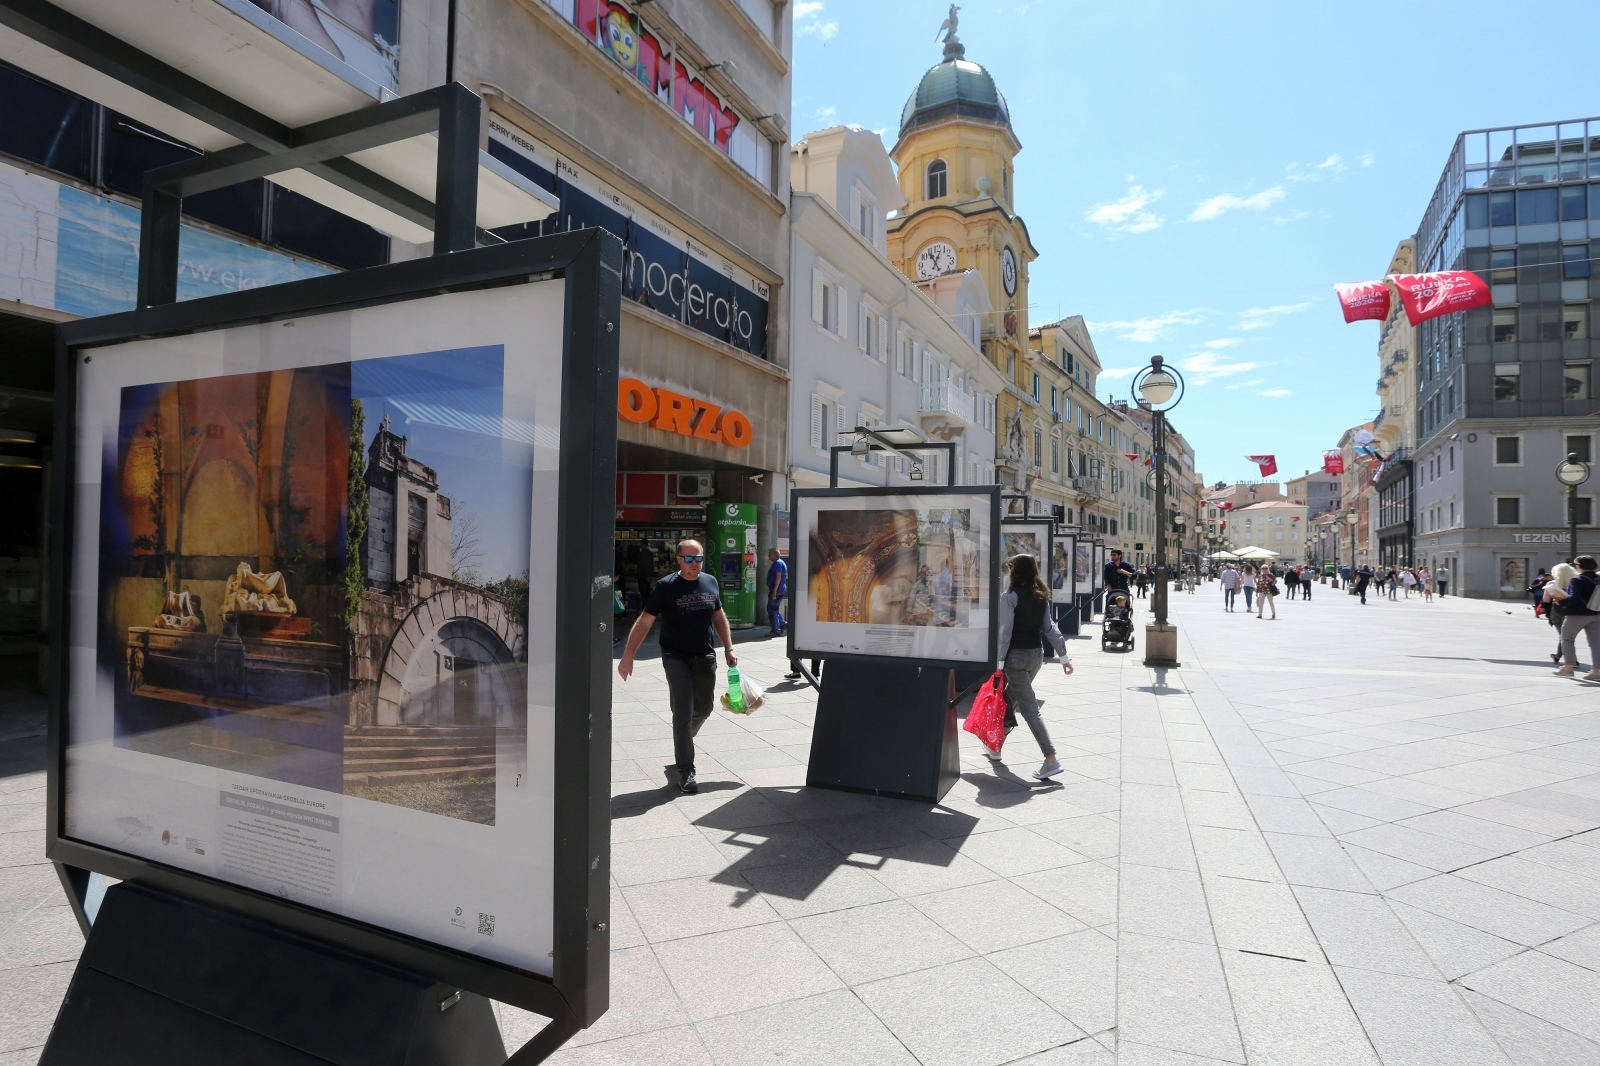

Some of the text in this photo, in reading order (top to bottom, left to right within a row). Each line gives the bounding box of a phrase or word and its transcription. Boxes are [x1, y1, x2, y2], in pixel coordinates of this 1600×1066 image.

[511, 133, 535, 153] WEBER
[557, 159, 578, 178] BRAX
[598, 187, 635, 213] CASA MODA
[650, 219, 672, 237] BASLER
[933, 244, 941, 253] 12
[946, 248, 951, 257] 2
[921, 252, 928, 261] 10
[949, 256, 955, 265] 3
[918, 261, 924, 270] 9
[920, 269, 927, 278] 8
[751, 279, 768, 297] 1. kat
[1410, 276, 1467, 292] RIJEKA
[1347, 291, 1382, 303] RIJEKA
[231, 783, 249, 792] TJEDAN
[283, 794, 306, 805] GROBLJA
[306, 800, 326, 810] EUROPE
[303, 814, 332, 827] WHITEHEAD
